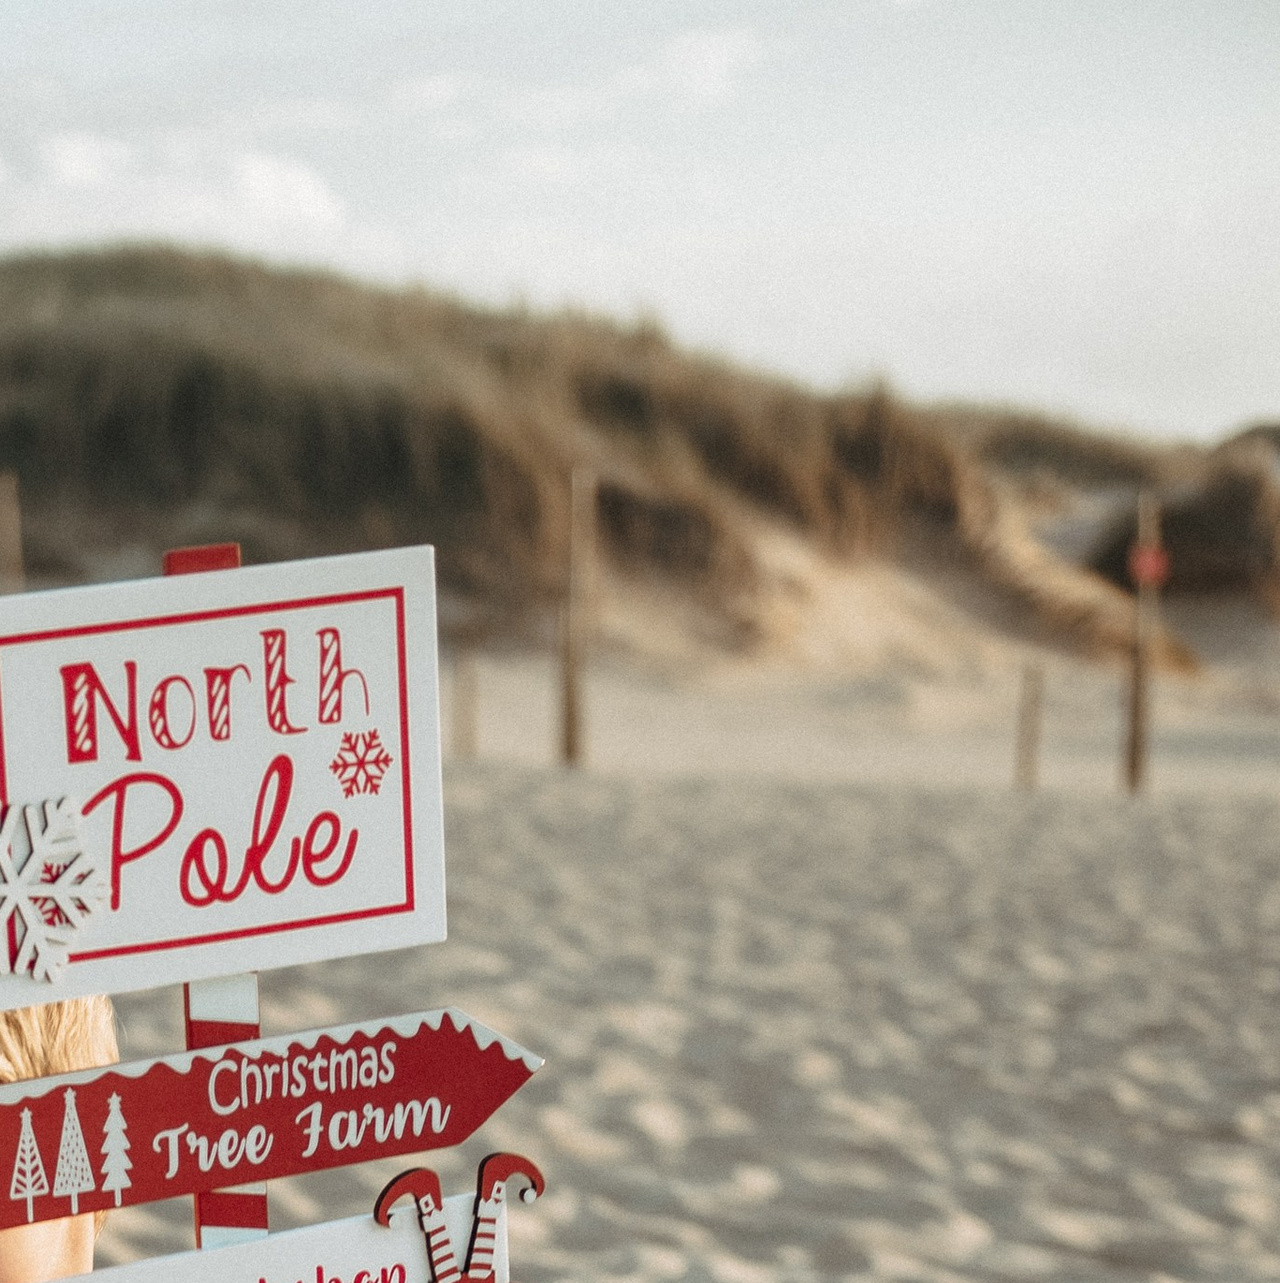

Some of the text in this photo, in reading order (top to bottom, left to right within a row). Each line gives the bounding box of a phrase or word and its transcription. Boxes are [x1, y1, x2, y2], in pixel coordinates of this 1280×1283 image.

[58, 626, 371, 765] North
[81, 752, 359, 912] Pole
[207, 1041, 397, 1116] Christmas
[152, 1096, 452, 1180] Tree Farm
